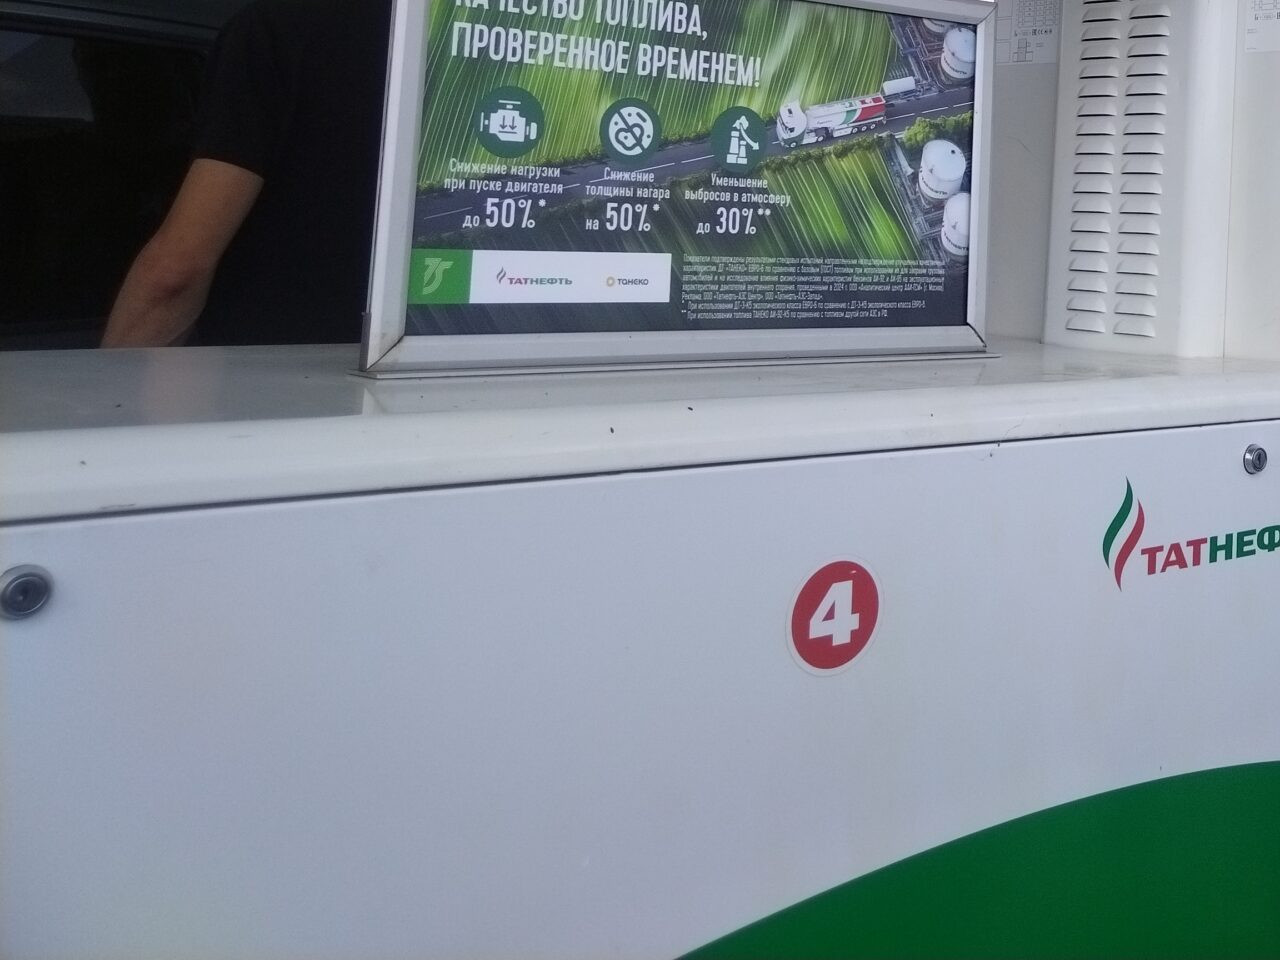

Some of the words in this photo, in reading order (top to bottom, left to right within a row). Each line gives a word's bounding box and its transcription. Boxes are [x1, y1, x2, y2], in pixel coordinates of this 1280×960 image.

[451, 21, 629, 73] ПРОВЕРЕННОЕ
[637, 44, 762, 88] ВРЕМЕНЕМ!
[449, 158, 508, 175] Снижение
[510, 164, 561, 179] нагрузки
[603, 167, 655, 183] Снижение
[444, 177, 466, 195] при
[469, 178, 502, 193] пуске
[505, 180, 564, 195] двигателя
[710, 174, 768, 189] Уменьшение
[585, 183, 634, 198] толщины
[636, 186, 671, 199] нагара
[684, 189, 731, 203] выбросов
[733, 192, 739, 202] в
[741, 192, 791, 207] атмосферу
[462, 214, 480, 228] до
[585, 217, 599, 230] на
[696, 223, 710, 235] до
[508, 277, 573, 286] ТАТНЕФТЬ
[808, 579, 860, 647] 4
